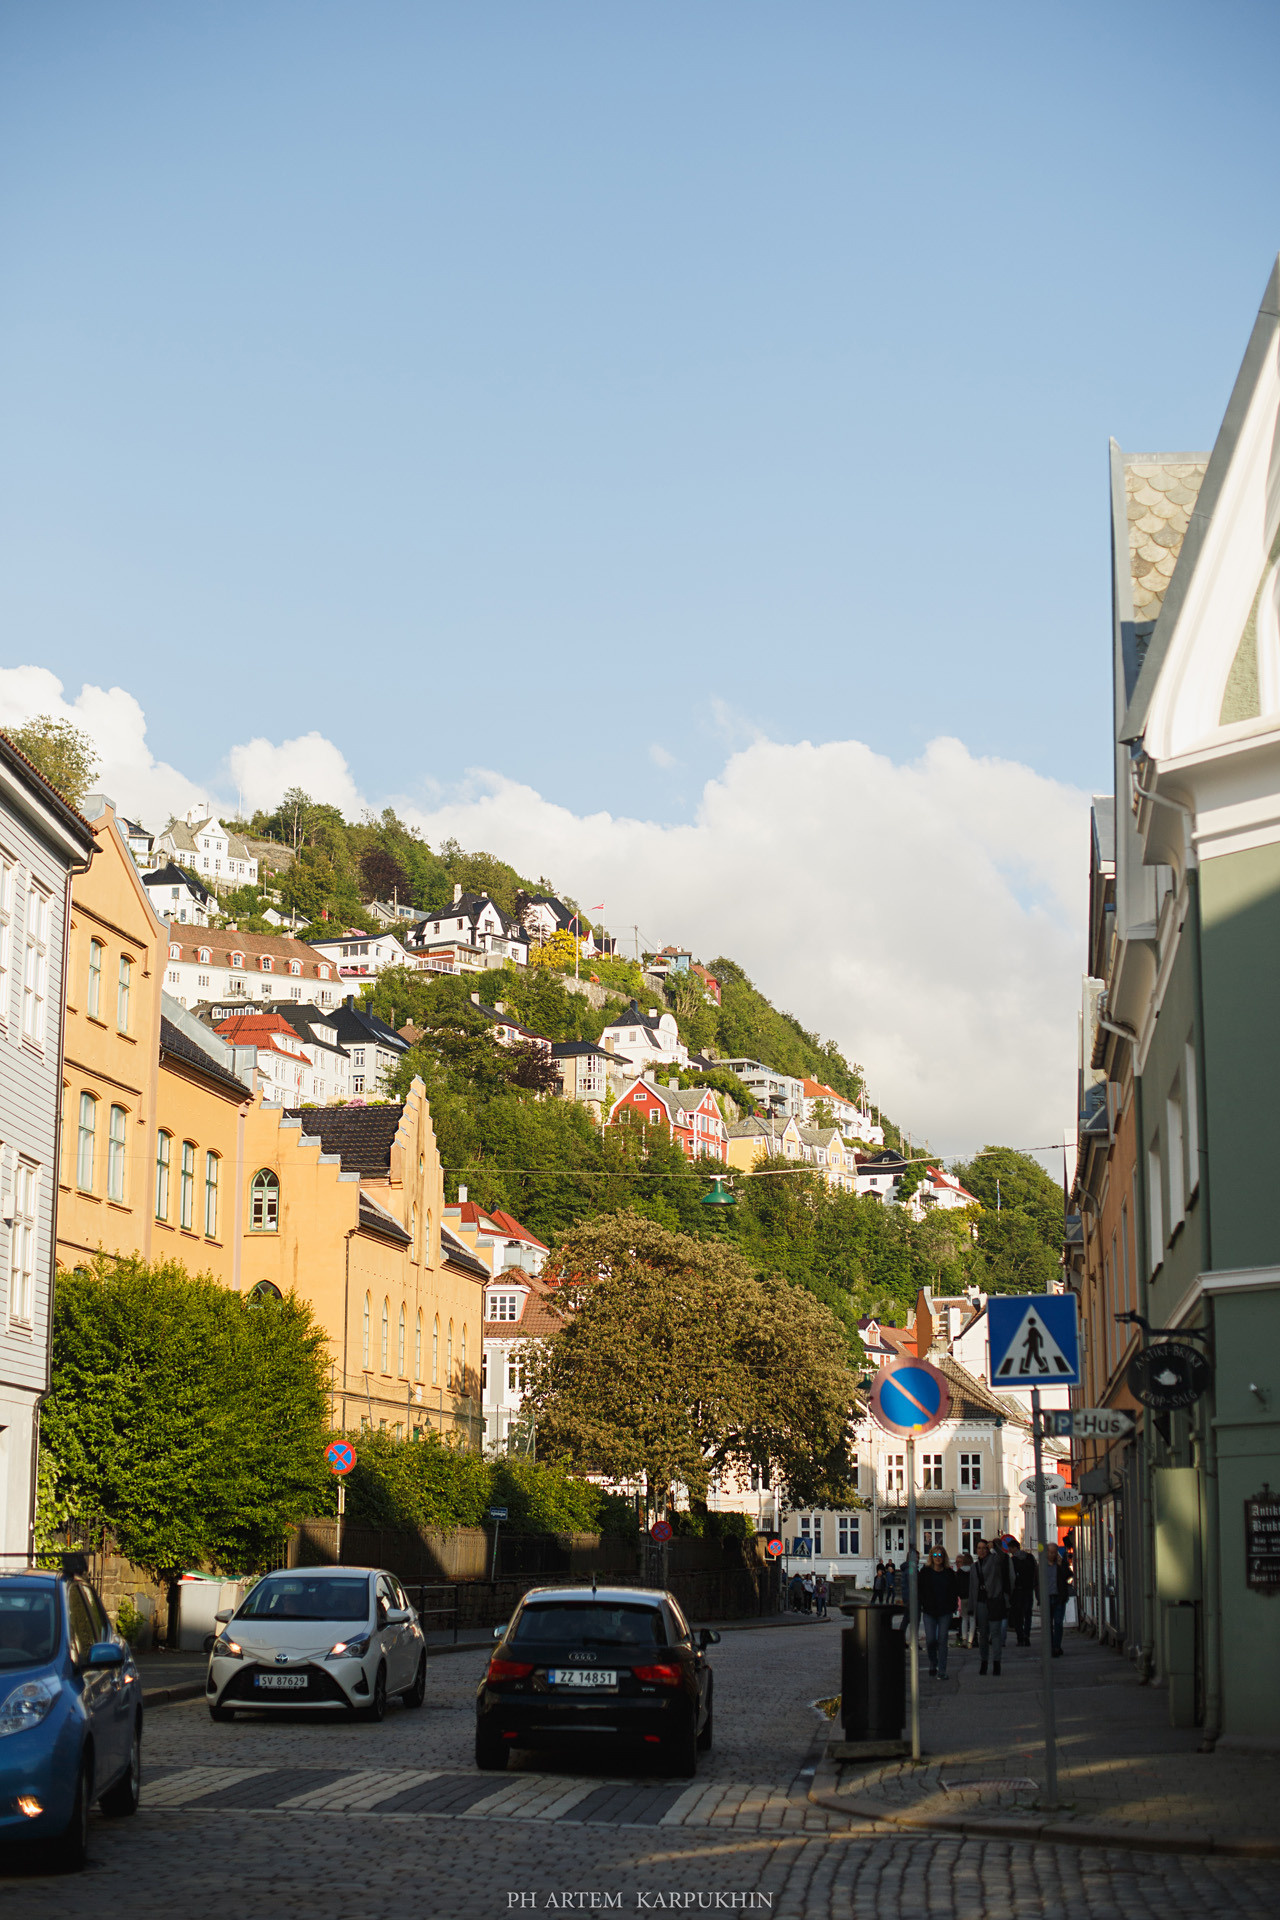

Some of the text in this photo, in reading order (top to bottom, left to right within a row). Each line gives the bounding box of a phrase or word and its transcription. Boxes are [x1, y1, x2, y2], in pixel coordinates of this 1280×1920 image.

[1053, 1491, 1079, 1503] Huldra
[262, 1676, 305, 1686] SV 87629
[560, 1671, 612, 1684] ZZ 14851
